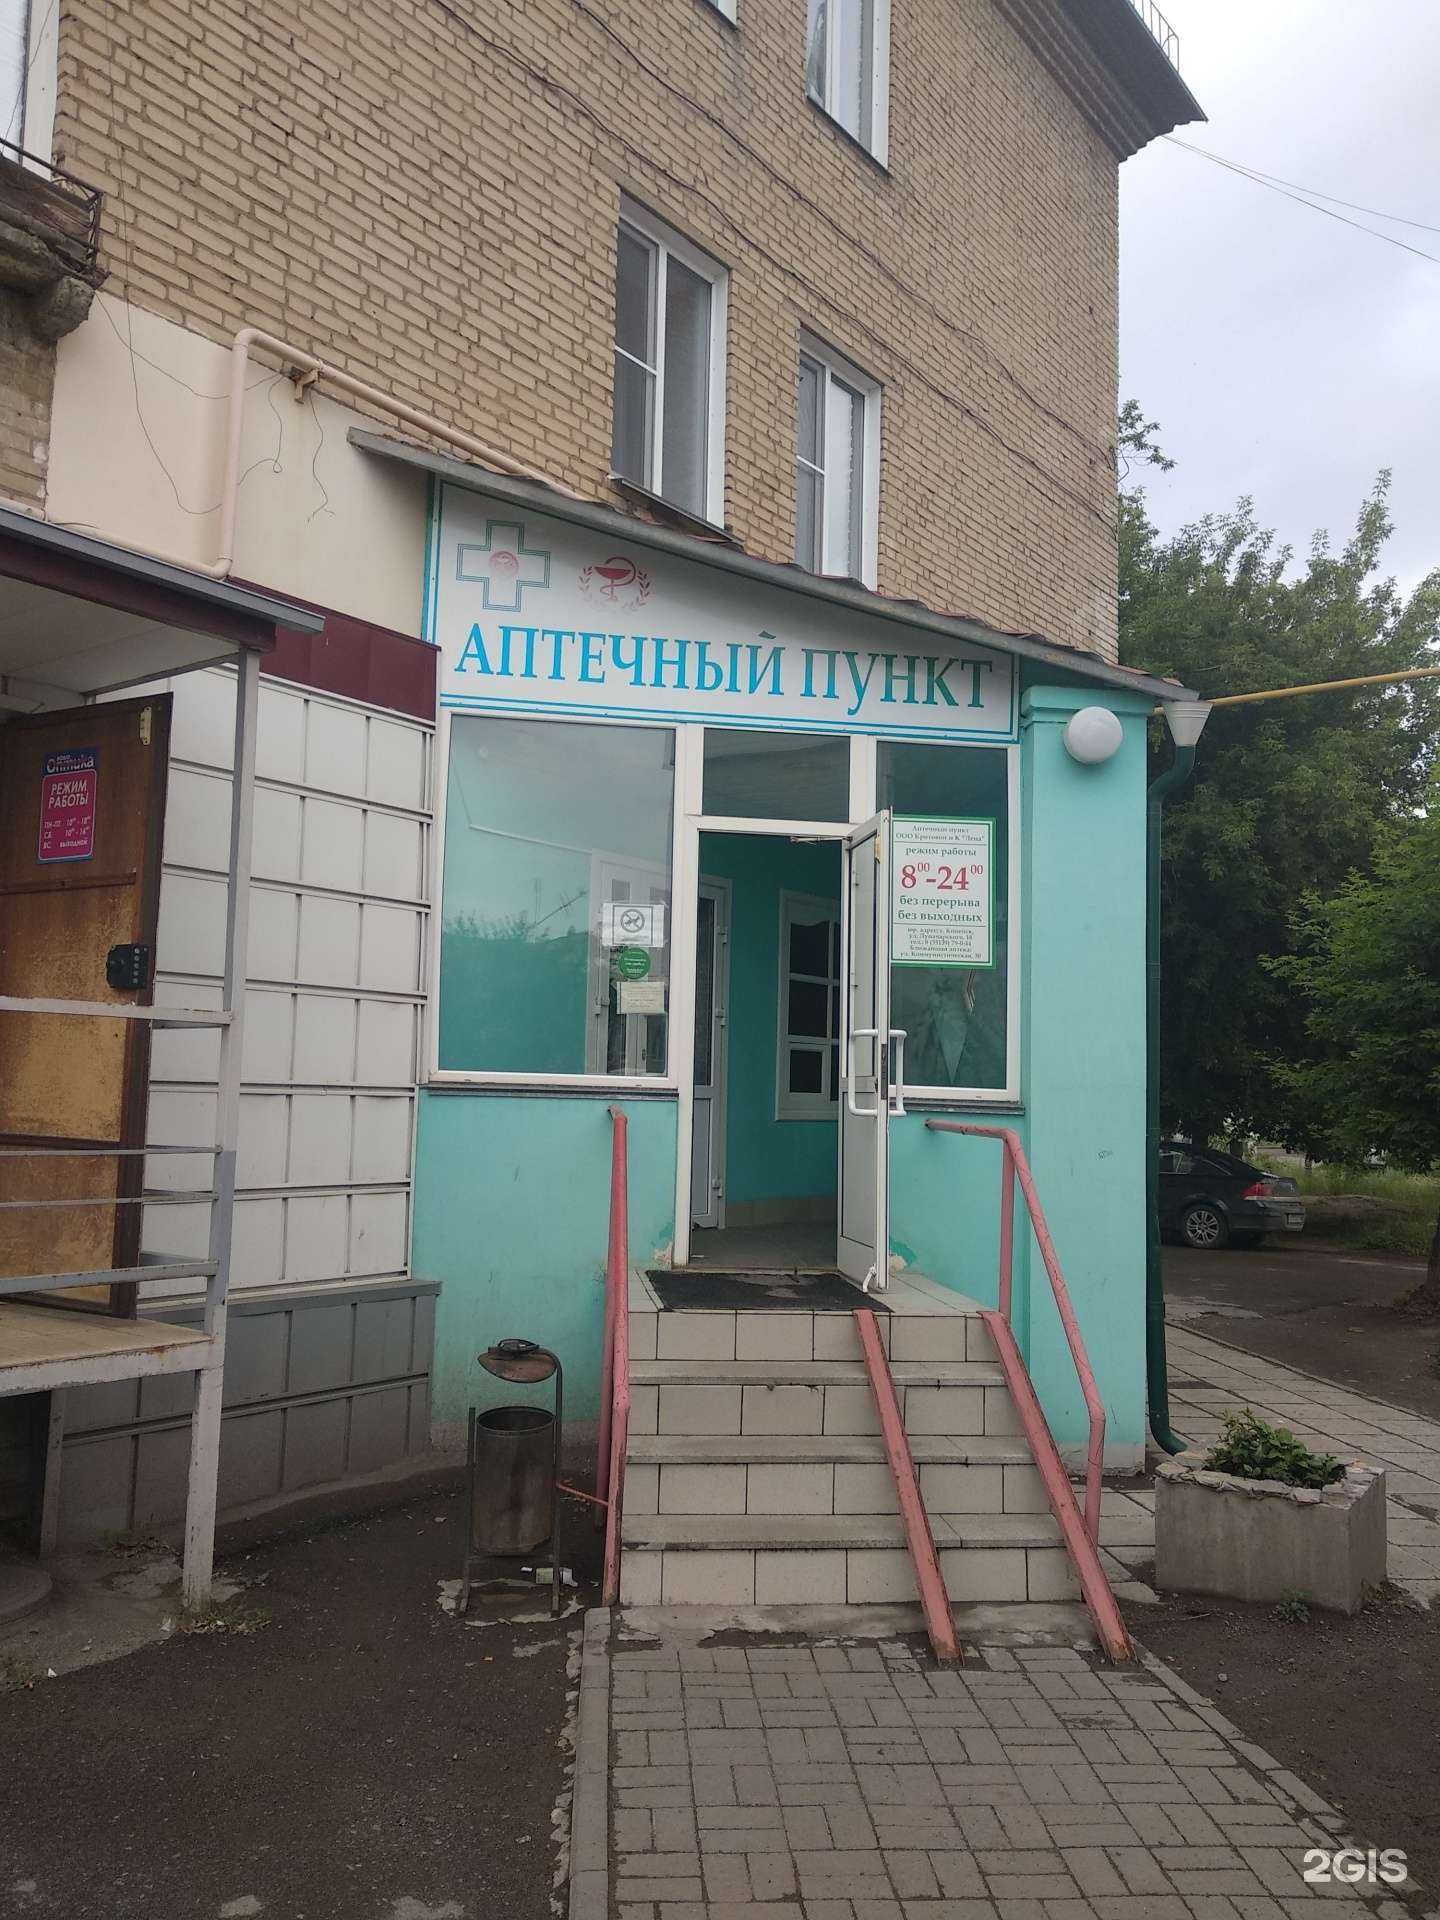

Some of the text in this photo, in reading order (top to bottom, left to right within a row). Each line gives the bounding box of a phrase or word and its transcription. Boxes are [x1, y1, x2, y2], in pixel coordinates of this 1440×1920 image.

[454, 623, 993, 716] АПТЕЧНЫЙ ПУНКТ
[50, 780, 87, 796] РЕЖИМ
[48, 792, 88, 809] РАБОТЫ
[905, 847, 977, 857] режим работы
[899, 895, 980, 909] без перерыва
[898, 909, 983, 923] без выходных
